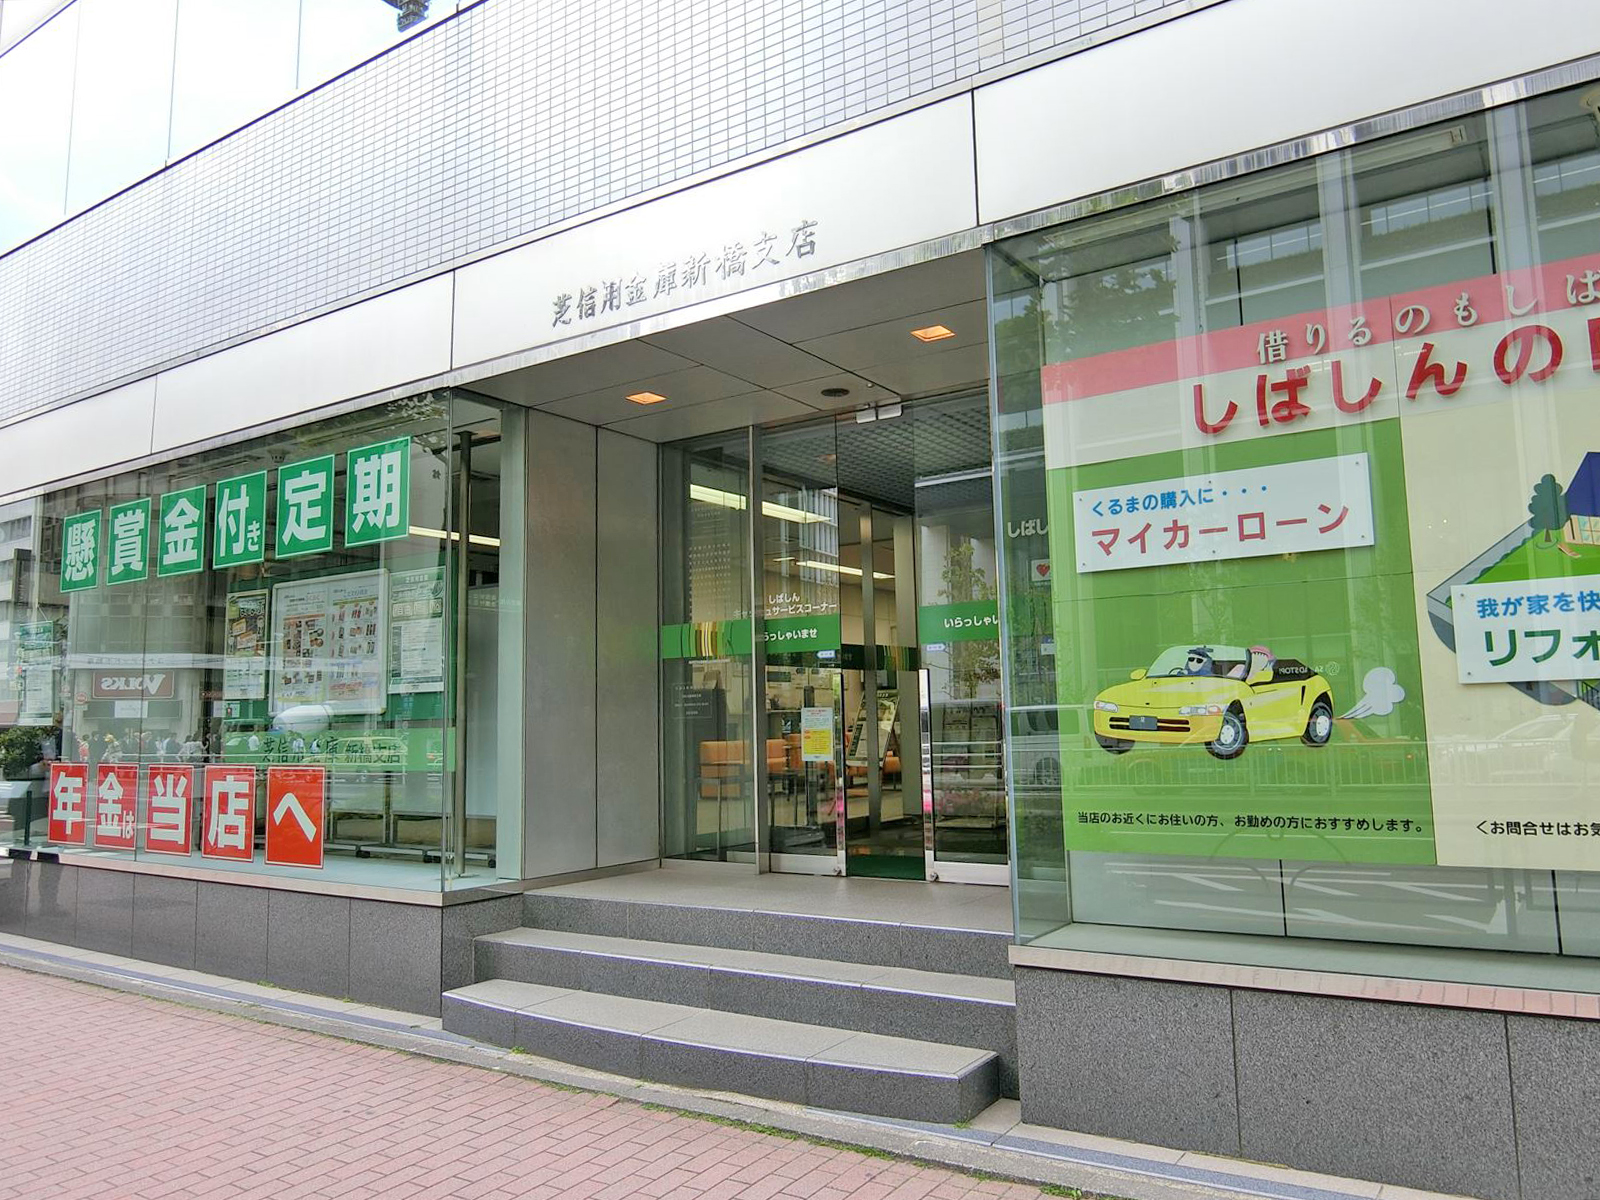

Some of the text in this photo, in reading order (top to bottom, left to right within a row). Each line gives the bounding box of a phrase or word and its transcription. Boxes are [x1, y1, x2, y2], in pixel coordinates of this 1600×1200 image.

[551, 219, 819, 329] 芝信用金庫新橋支店
[1193, 316, 1600, 436] しばしんの
[64, 449, 402, 582] 懸賞金付き定期
[1090, 503, 1350, 557] マイカーローン
[763, 628, 818, 642] らっしゃいませ
[768, 592, 801, 604] しばしん
[52, 771, 318, 850] 年金は当店へ
